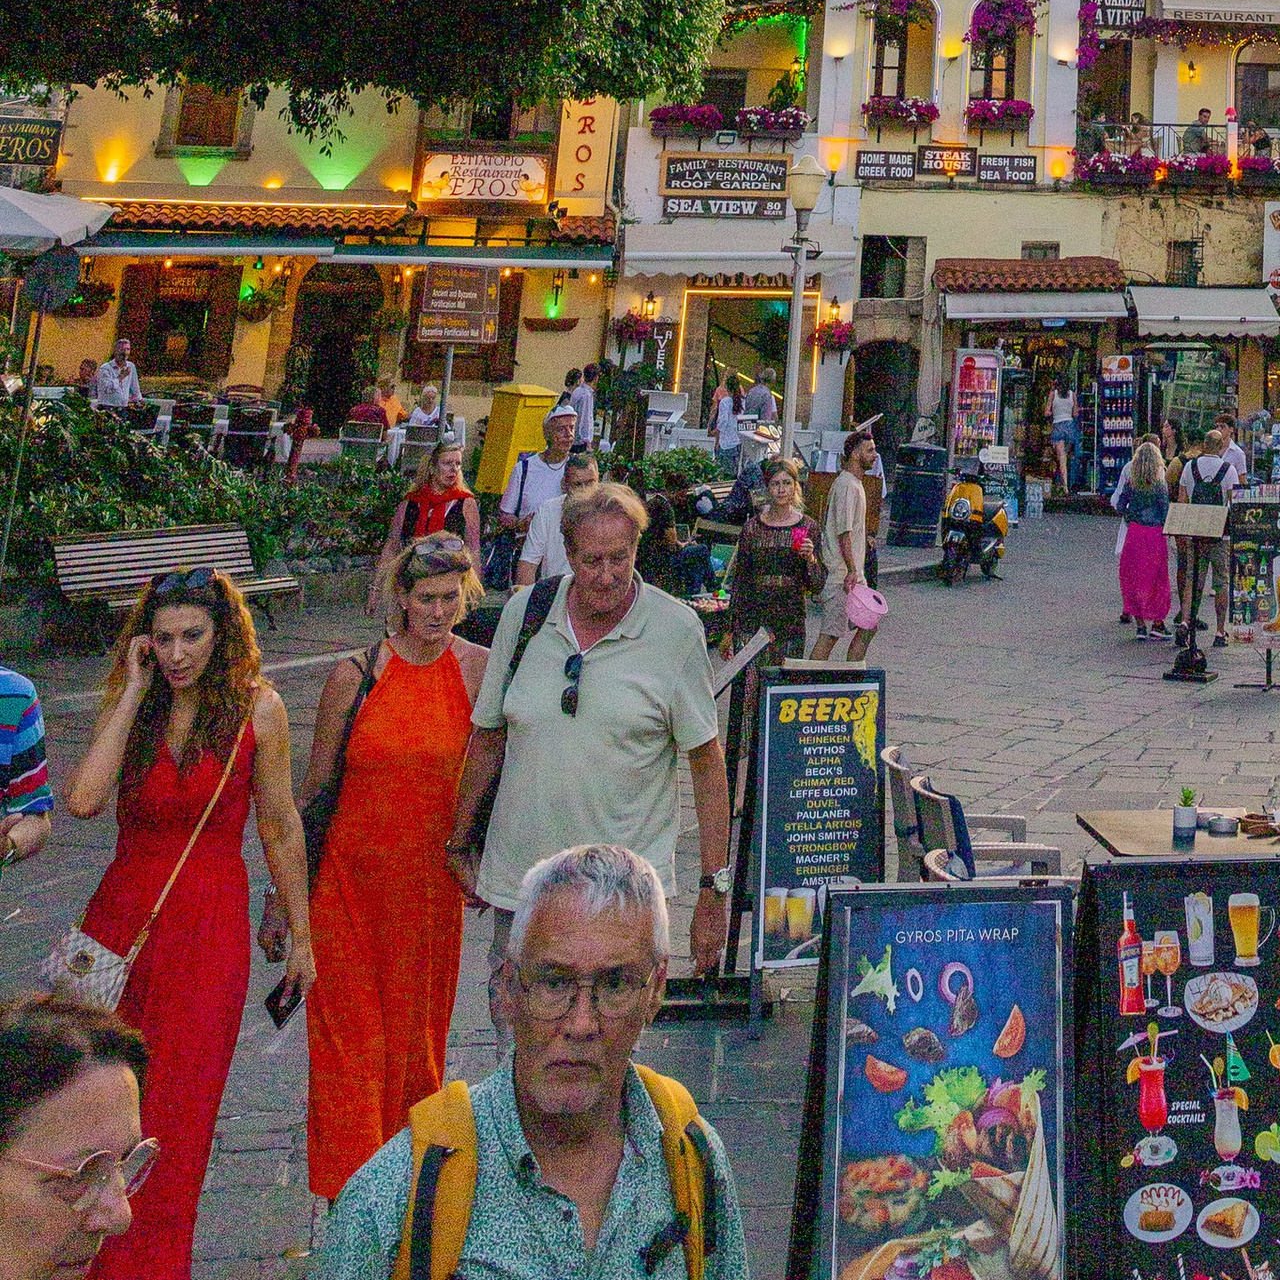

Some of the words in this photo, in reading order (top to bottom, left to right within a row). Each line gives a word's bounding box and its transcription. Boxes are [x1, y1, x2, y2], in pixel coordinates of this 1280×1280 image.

[1174, 10, 1275, 23] RESTAURANT
[0, 136, 53, 160] EROS
[571, 98, 596, 193] ROS
[860, 153, 885, 164] HOME
[889, 154, 913, 165] MADE
[924, 151, 971, 161] STEAK
[669, 159, 708, 174] FAMILY
[717, 160, 785, 176] RESTAURANT
[922, 160, 971, 171] HOUSE
[981, 157, 1009, 167] FRESH
[1014, 157, 1035, 167] FISH
[450, 166, 523, 180] Restaurant
[685, 172, 701, 180] LA
[706, 172, 767, 181] VERANDA
[858, 166, 887, 177] GREEK
[890, 167, 913, 177] FOOD
[980, 170, 1000, 180] SEA
[1006, 171, 1034, 181] FOOD
[449, 178, 520, 197] EROS
[671, 180, 712, 189] ROOF
[720, 181, 781, 190] GARDEN
[667, 199, 703, 213] SEA
[708, 200, 758, 215] VIEW
[766, 202, 781, 210] 80
[779, 696, 869, 723] BEERS
[802, 724, 847, 734] GUINESS
[798, 735, 850, 745] HEINEKEN
[803, 746, 845, 755] MYTHOS
[807, 757, 841, 766] ALPHA
[805, 767, 843, 776] BECK'S
[793, 778, 830, 787] CHIMAY
[834, 777, 854, 785] RED
[790, 789, 820, 798] LEFFE
[823, 788, 858, 797] BLOND
[807, 799, 840, 808] DUVEL
[797, 809, 850, 820] PAULANER
[784, 822, 822, 832] STELLA
[825, 819, 862, 829] ARTOIS
[787, 833, 815, 842] JOHN
[818, 830, 859, 841] SMITH'S
[789, 842, 856, 853] STRONGBOW
[795, 853, 850, 864] MAGNER'S
[796, 864, 849, 875] ERDINGER
[802, 876, 844, 886] AMSTEL
[895, 930, 942, 944] GYROS
[947, 929, 975, 942] PITA
[978, 927, 1019, 940] WRAP
[1171, 1100, 1201, 1111] SPECIAL
[1167, 1113, 1206, 1124] COCKTAILS
